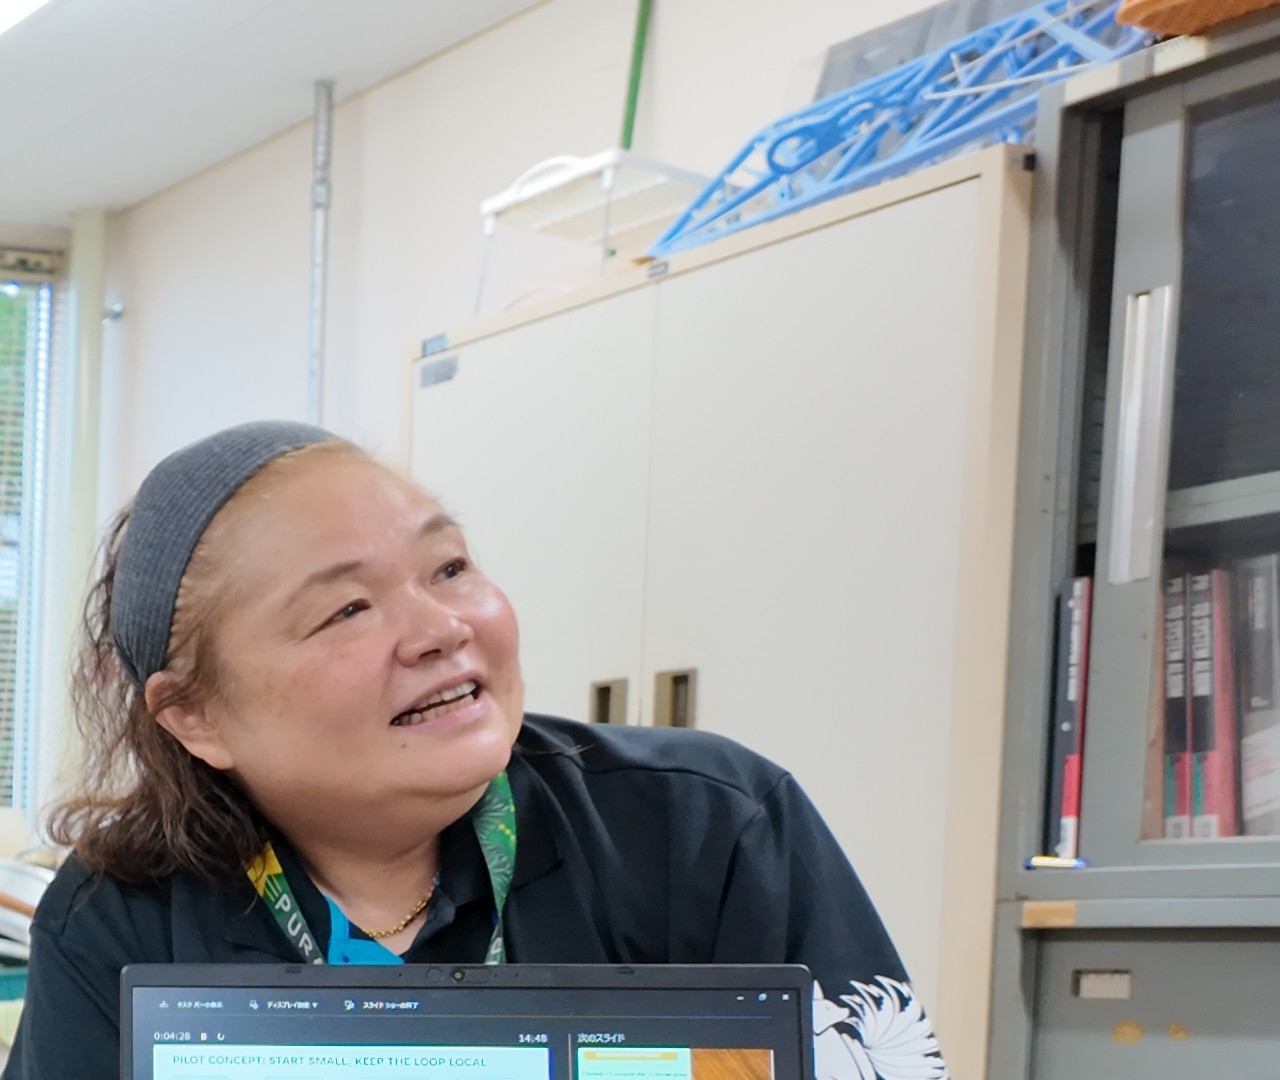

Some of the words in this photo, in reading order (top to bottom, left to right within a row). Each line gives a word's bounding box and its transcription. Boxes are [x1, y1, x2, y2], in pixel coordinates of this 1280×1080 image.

[275, 893, 323, 965] PUR
[577, 1033, 625, 1043] 次のスライド
[173, 1055, 205, 1064] PILOT
[269, 1056, 304, 1066] START
[355, 1057, 384, 1066] KEEP
[389, 1057, 410, 1066] THE
[414, 1058, 445, 1067] LOOP
[449, 1058, 487, 1067] LOCAL
